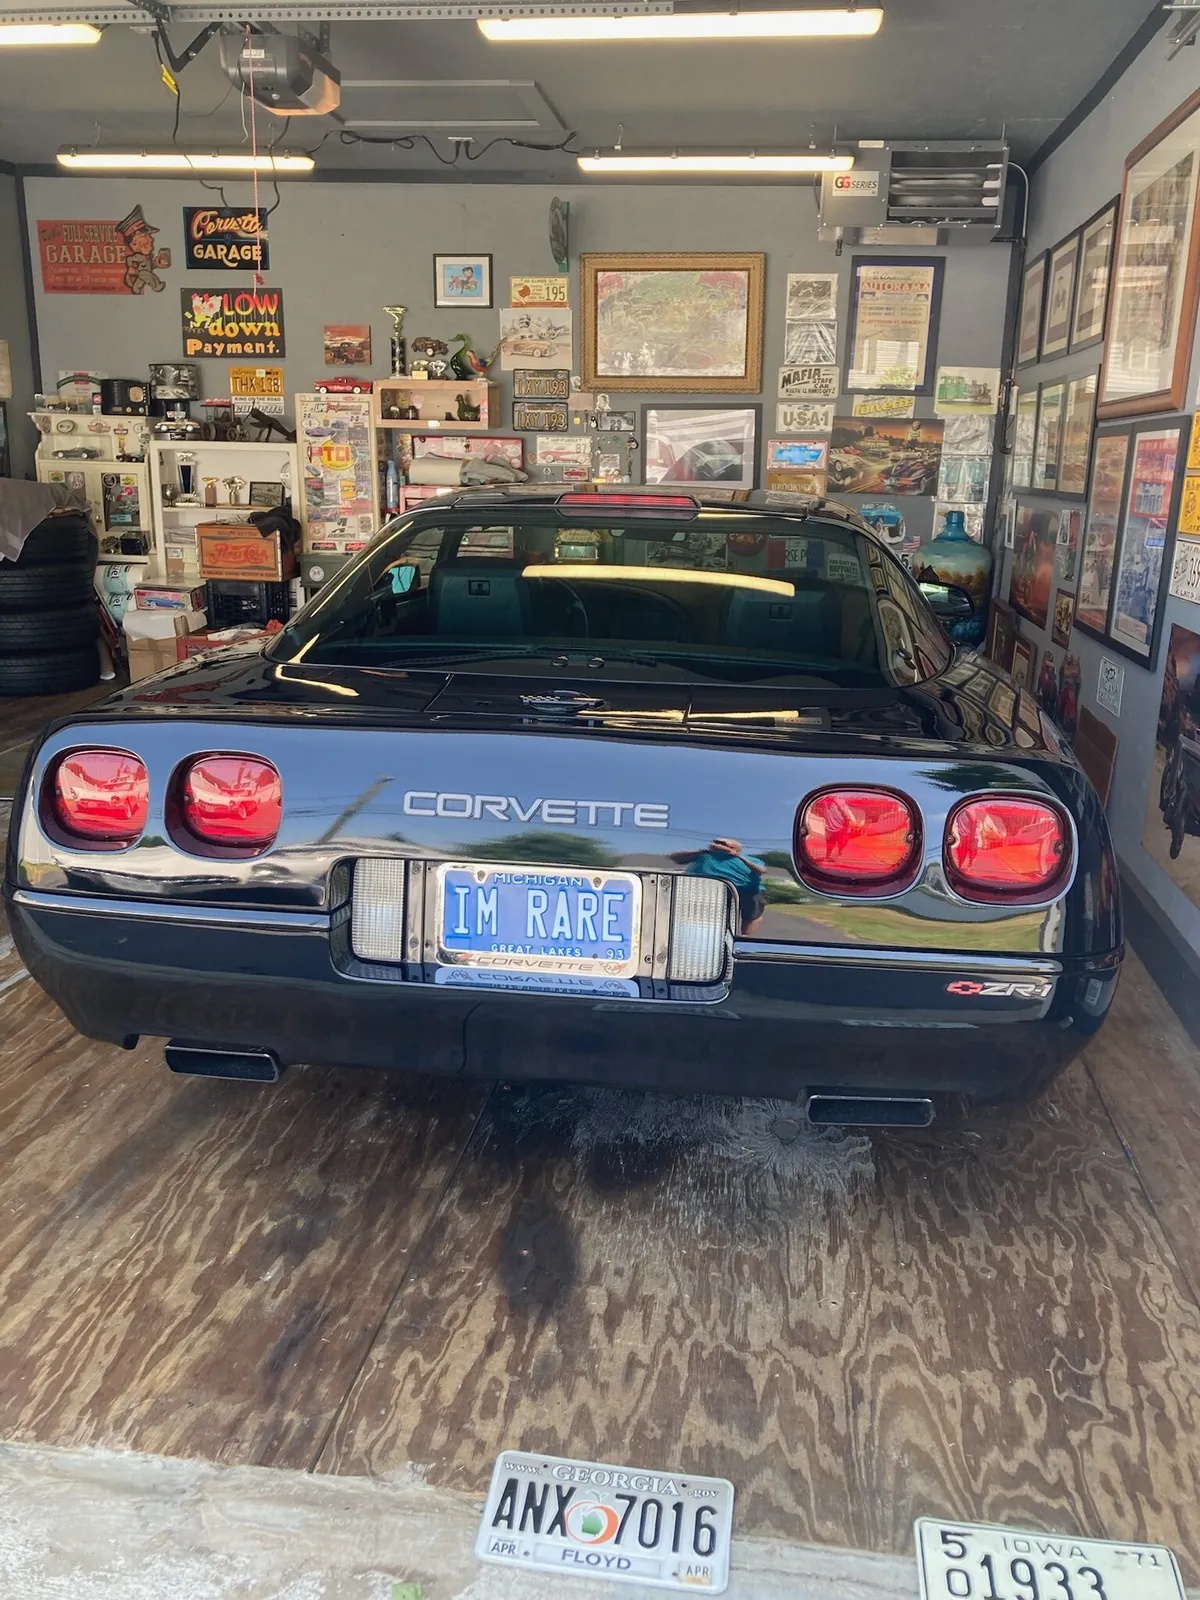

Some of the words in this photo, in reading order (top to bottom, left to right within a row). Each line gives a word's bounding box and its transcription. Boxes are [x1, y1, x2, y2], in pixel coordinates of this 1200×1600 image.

[851, 181, 877, 189] SERIES
[62, 224, 83, 243] FULL
[84, 224, 118, 243] SERVICE
[45, 244, 126, 264] GARAGE
[193, 244, 262, 267] GARAGE
[545, 286, 566, 301] 195
[861, 281, 930, 291] AUTORAMA
[222, 293, 279, 316] LOW
[208, 317, 280, 337] down
[186, 338, 280, 356] Payment.
[233, 376, 256, 393] THX
[545, 379, 566, 396] 193
[781, 368, 821, 389] MAFIA
[544, 412, 565, 429] 193
[323, 446, 350, 461] TCI
[829, 565, 859, 575] HAPPINESS
[403, 790, 670, 828] CORVETTE
[493, 872, 584, 886] MICHIGAN
[454, 886, 498, 936] IM
[526, 888, 625, 942] RARE
[491, 943, 532, 954] GREAT
[540, 945, 582, 957] LAKES
[606, 948, 625, 960] 93
[477, 955, 594, 971] CORVETTE
[979, 981, 1053, 997] ZR-1
[504, 1461, 542, 1475] www.
[551, 1463, 681, 1496] GEORGIA
[687, 1487, 720, 1499] .gov
[491, 1478, 576, 1538] ANX
[614, 1493, 718, 1557] 7016
[1002, 1537, 1088, 1561] IOWA
[491, 1540, 516, 1555] APR
[561, 1549, 632, 1570] FLOYD
[686, 1565, 709, 1577] APR
[980, 1554, 1107, 1600] 1933
